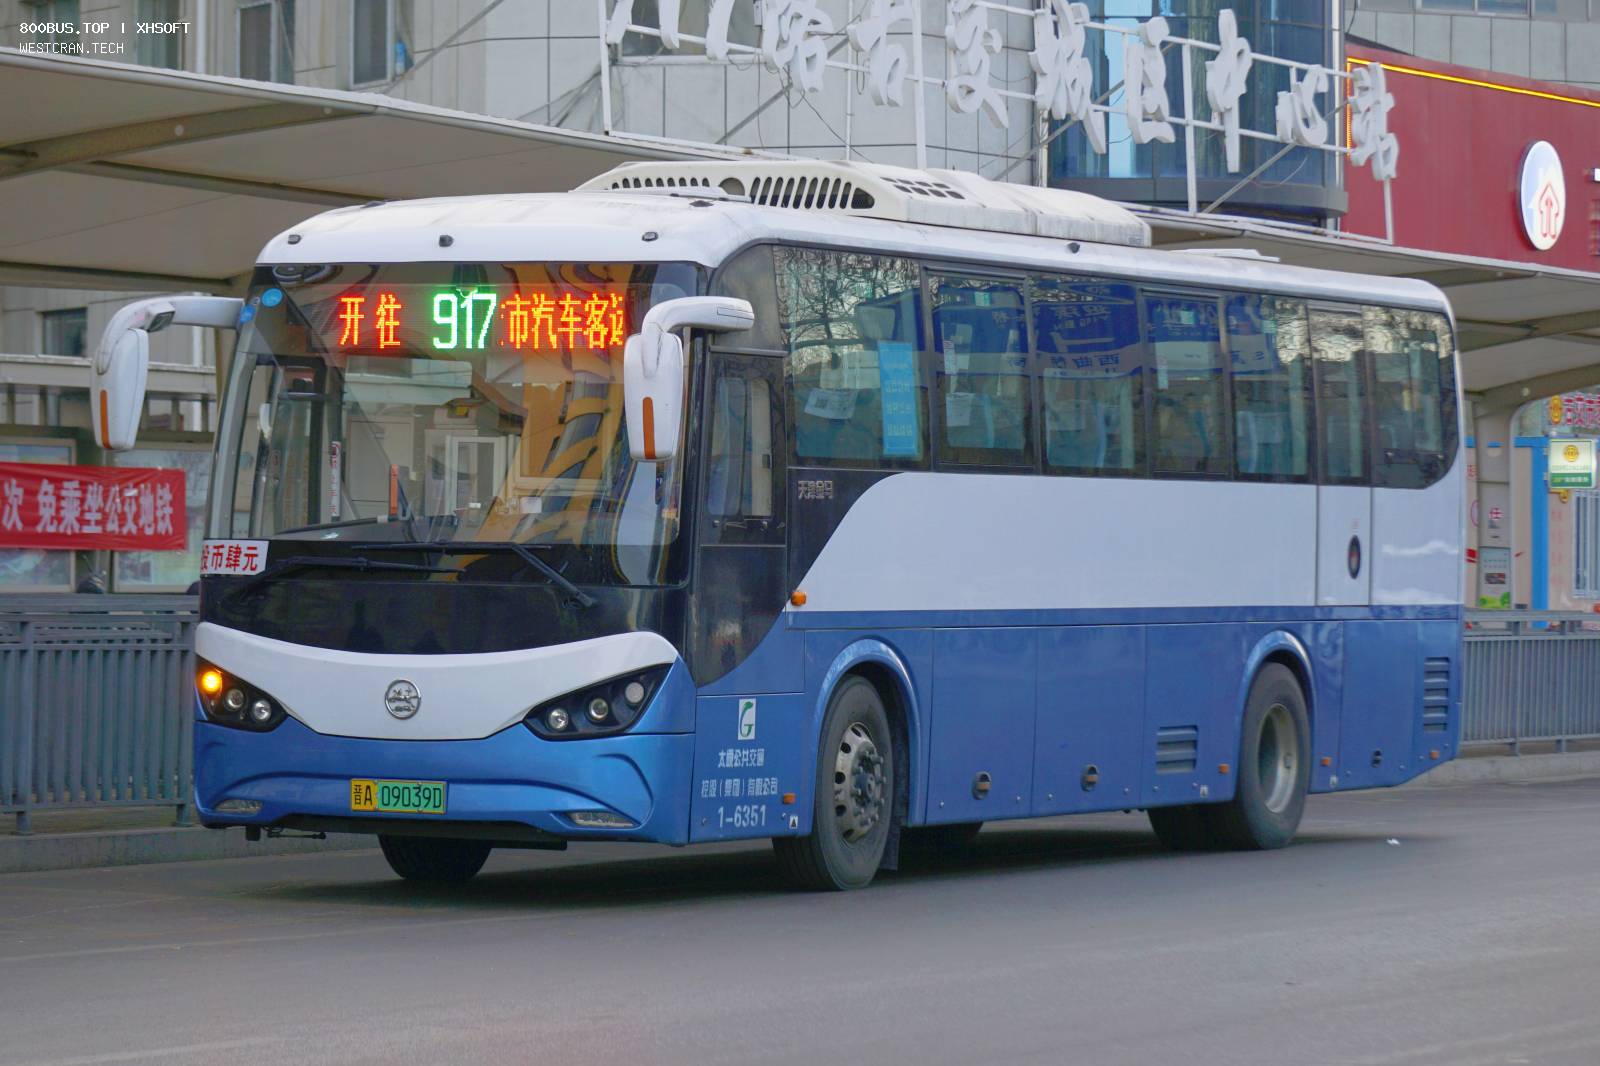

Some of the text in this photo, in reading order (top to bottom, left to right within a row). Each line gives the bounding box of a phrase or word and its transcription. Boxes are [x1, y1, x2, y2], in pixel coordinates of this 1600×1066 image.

[339, 294, 402, 349] 开往
[433, 293, 497, 349] 917
[2, 478, 174, 536] 次 免乘坐公交地铁
[718, 804, 767, 829] 1-6351
